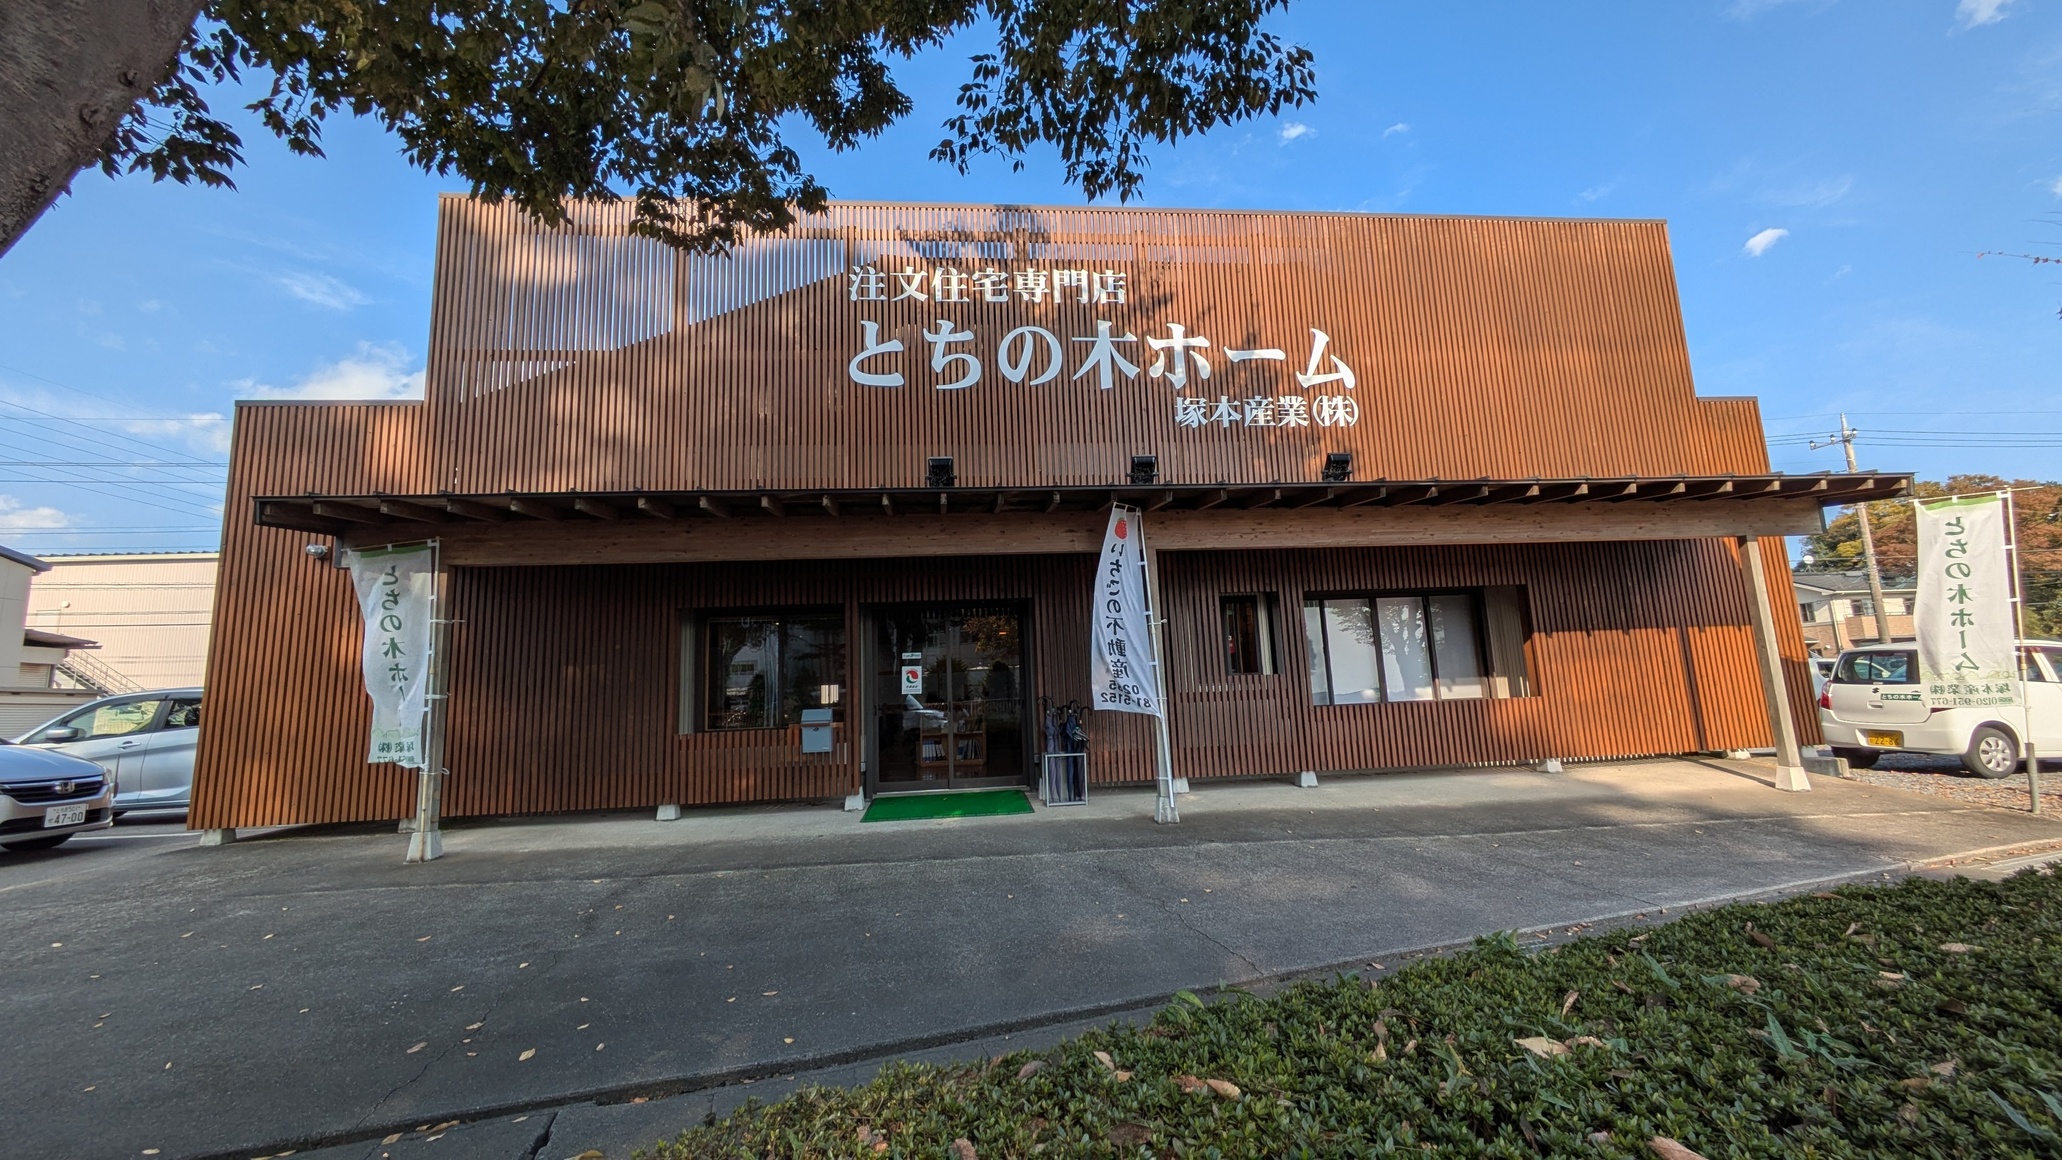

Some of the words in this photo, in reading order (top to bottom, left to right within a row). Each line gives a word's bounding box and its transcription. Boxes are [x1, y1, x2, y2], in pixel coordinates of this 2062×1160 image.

[848, 265, 1128, 304] 注文住宅専門店
[848, 320, 1357, 390] とちの木ホーム
[1875, 736, 1900, 746] 22-86
[55, 812, 83, 823] 47-00
